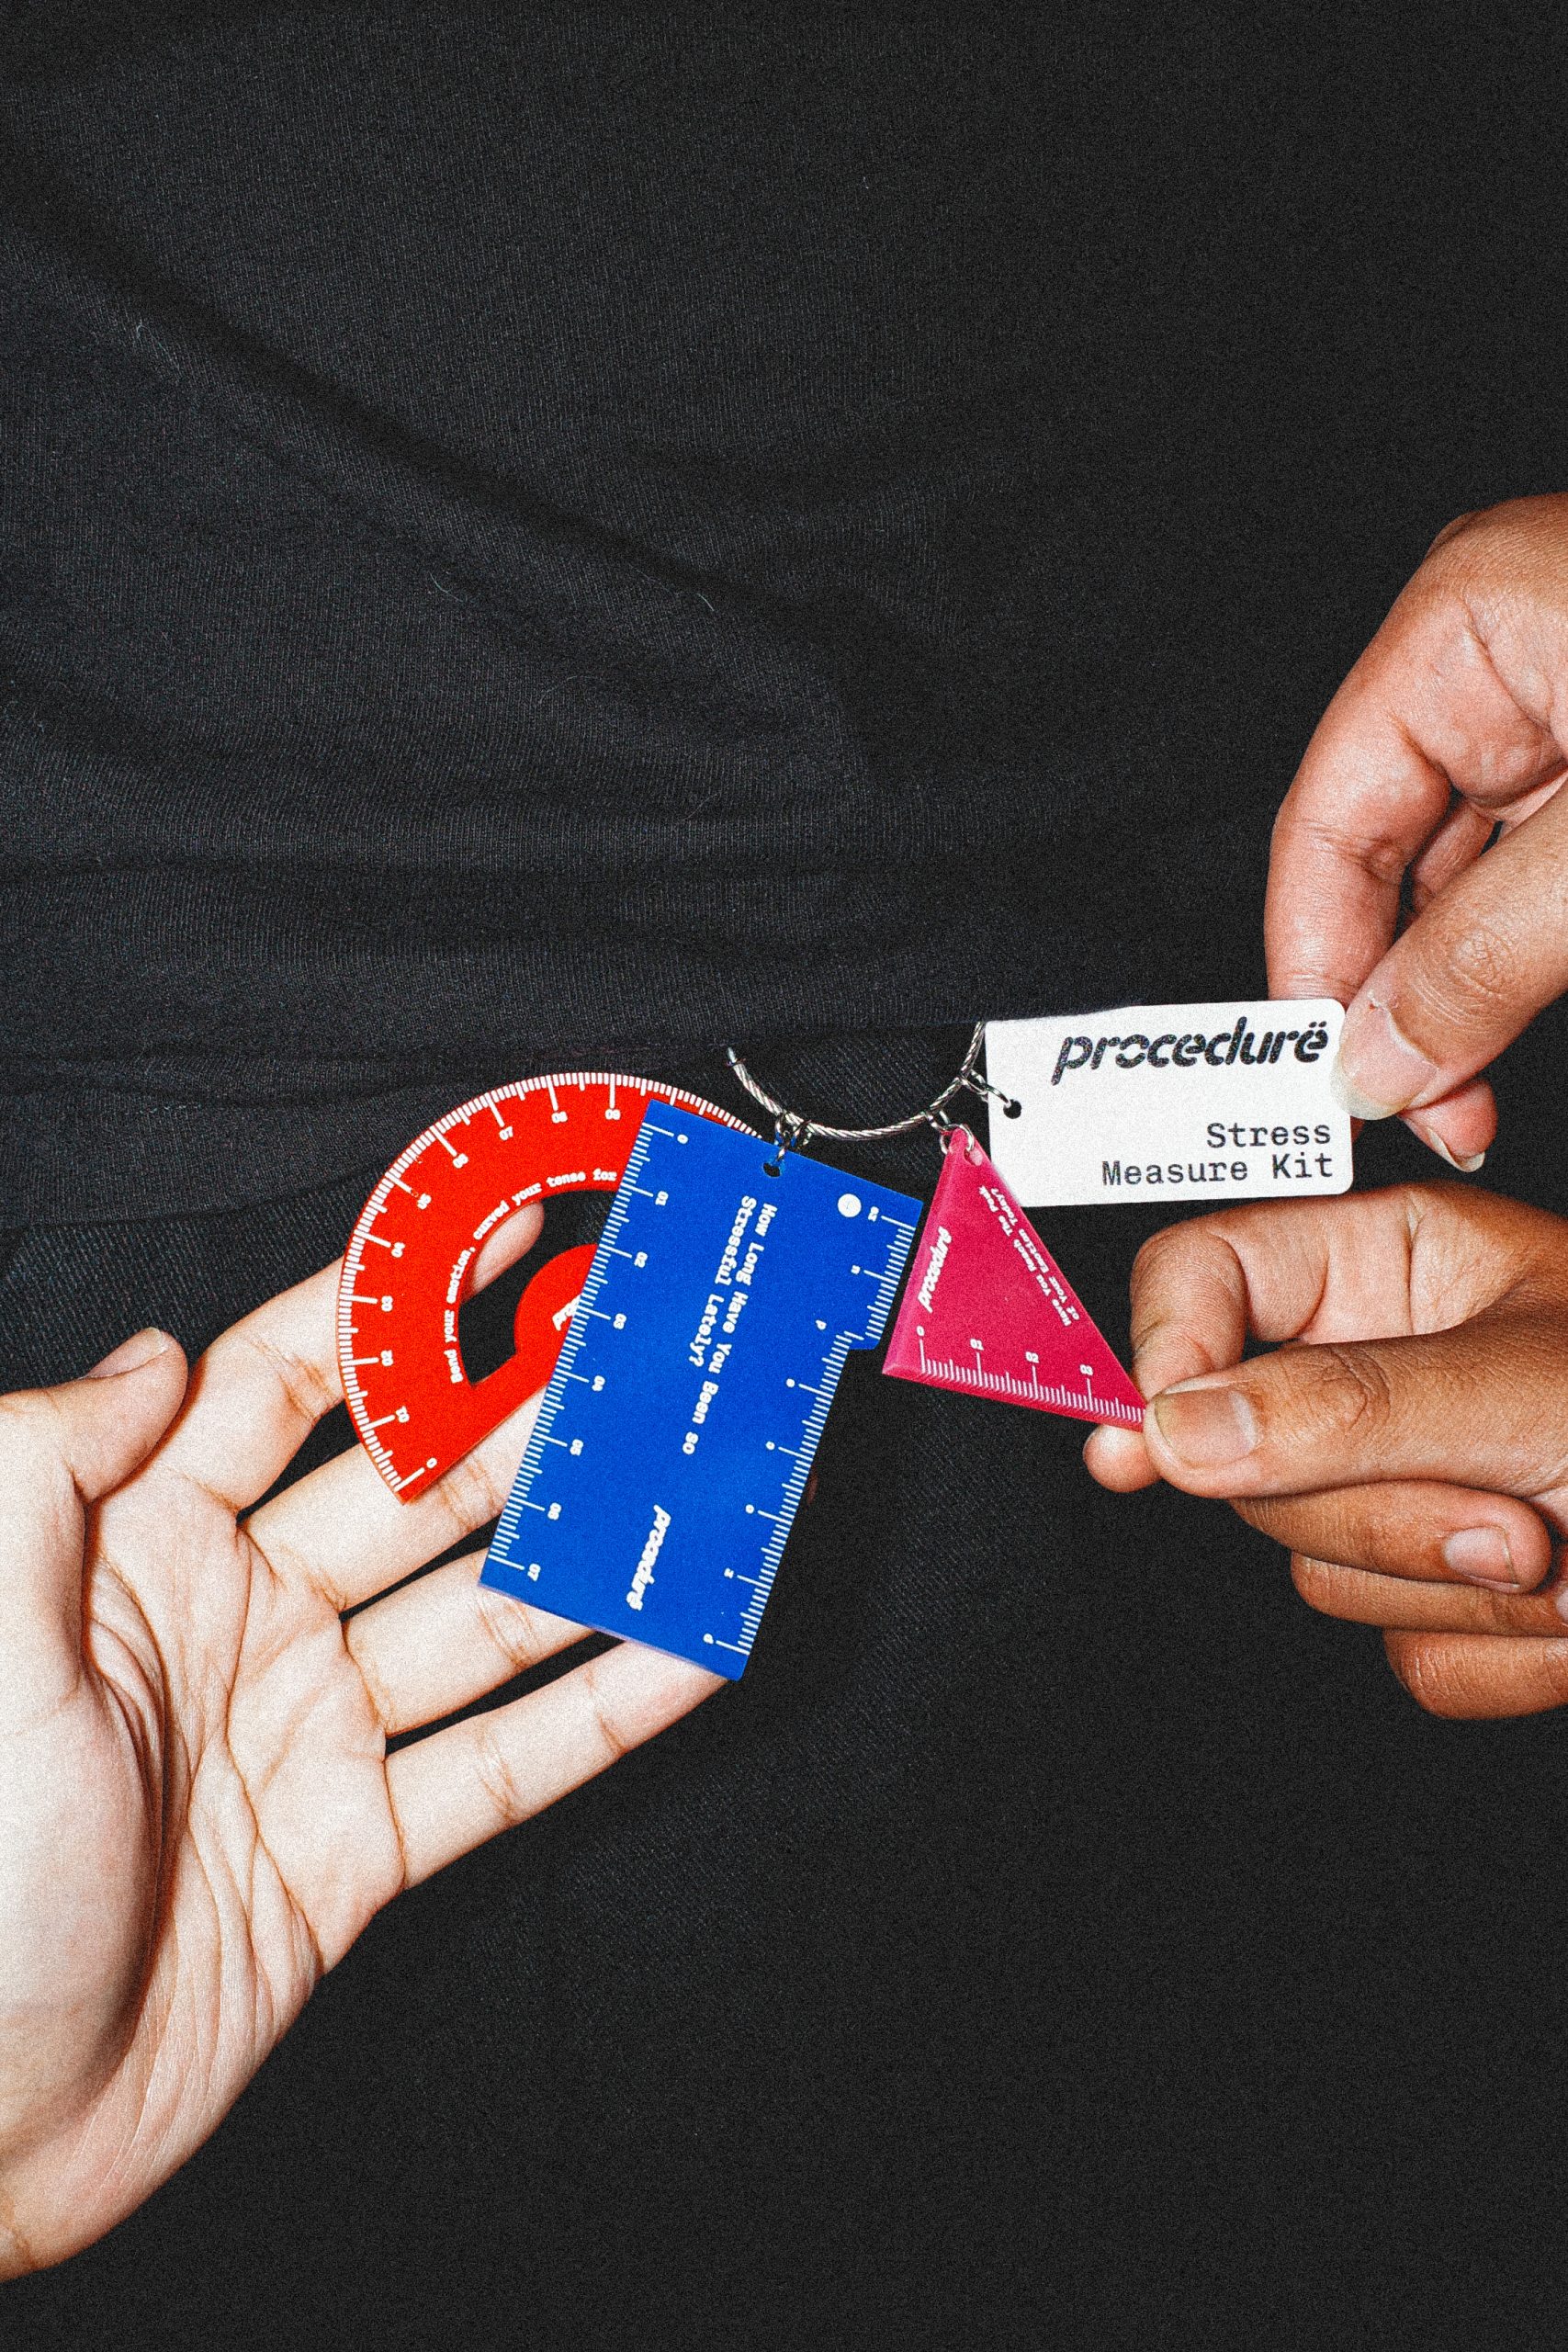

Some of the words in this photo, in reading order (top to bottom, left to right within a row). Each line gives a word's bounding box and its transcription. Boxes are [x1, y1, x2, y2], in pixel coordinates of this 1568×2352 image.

[1050, 1016, 1329, 1086] procedurë
[1206, 1122, 1332, 1149] Stress
[547, 1171, 586, 1188] tense
[592, 1168, 618, 1182] for
[1101, 1159, 1249, 1187] Measure
[1271, 1152, 1334, 1180] Kit
[511, 1182, 543, 1205] your
[655, 1191, 669, 1206] 01
[978, 1185, 998, 1213] Peak
[990, 1187, 1018, 1226] Today?
[473, 1200, 511, 1240] curved
[755, 1203, 778, 1237] How
[998, 1215, 1013, 1237] The
[715, 1195, 757, 1285] Stressful
[1018, 1228, 1050, 1273] Emotion
[634, 1251, 649, 1268] 02
[736, 1242, 765, 1286] Long
[1013, 1238, 1037, 1272] Reach
[446, 1247, 476, 1304] emotion,
[1035, 1273, 1052, 1296] You
[1048, 1276, 1067, 1304] Your
[444, 1309, 457, 1343] your
[613, 1313, 627, 1329] 03
[722, 1291, 749, 1334] Have
[1051, 1298, 1072, 1327] Have
[1066, 1306, 1080, 1320] of
[689, 1294, 725, 1367] Lately?
[444, 1349, 463, 1384] Bend
[708, 1343, 733, 1374] You
[592, 1375, 605, 1392] 04
[692, 1380, 719, 1425] Been
[570, 1439, 584, 1456] 05
[682, 1431, 699, 1455] so
[527, 1563, 541, 1581] 07
